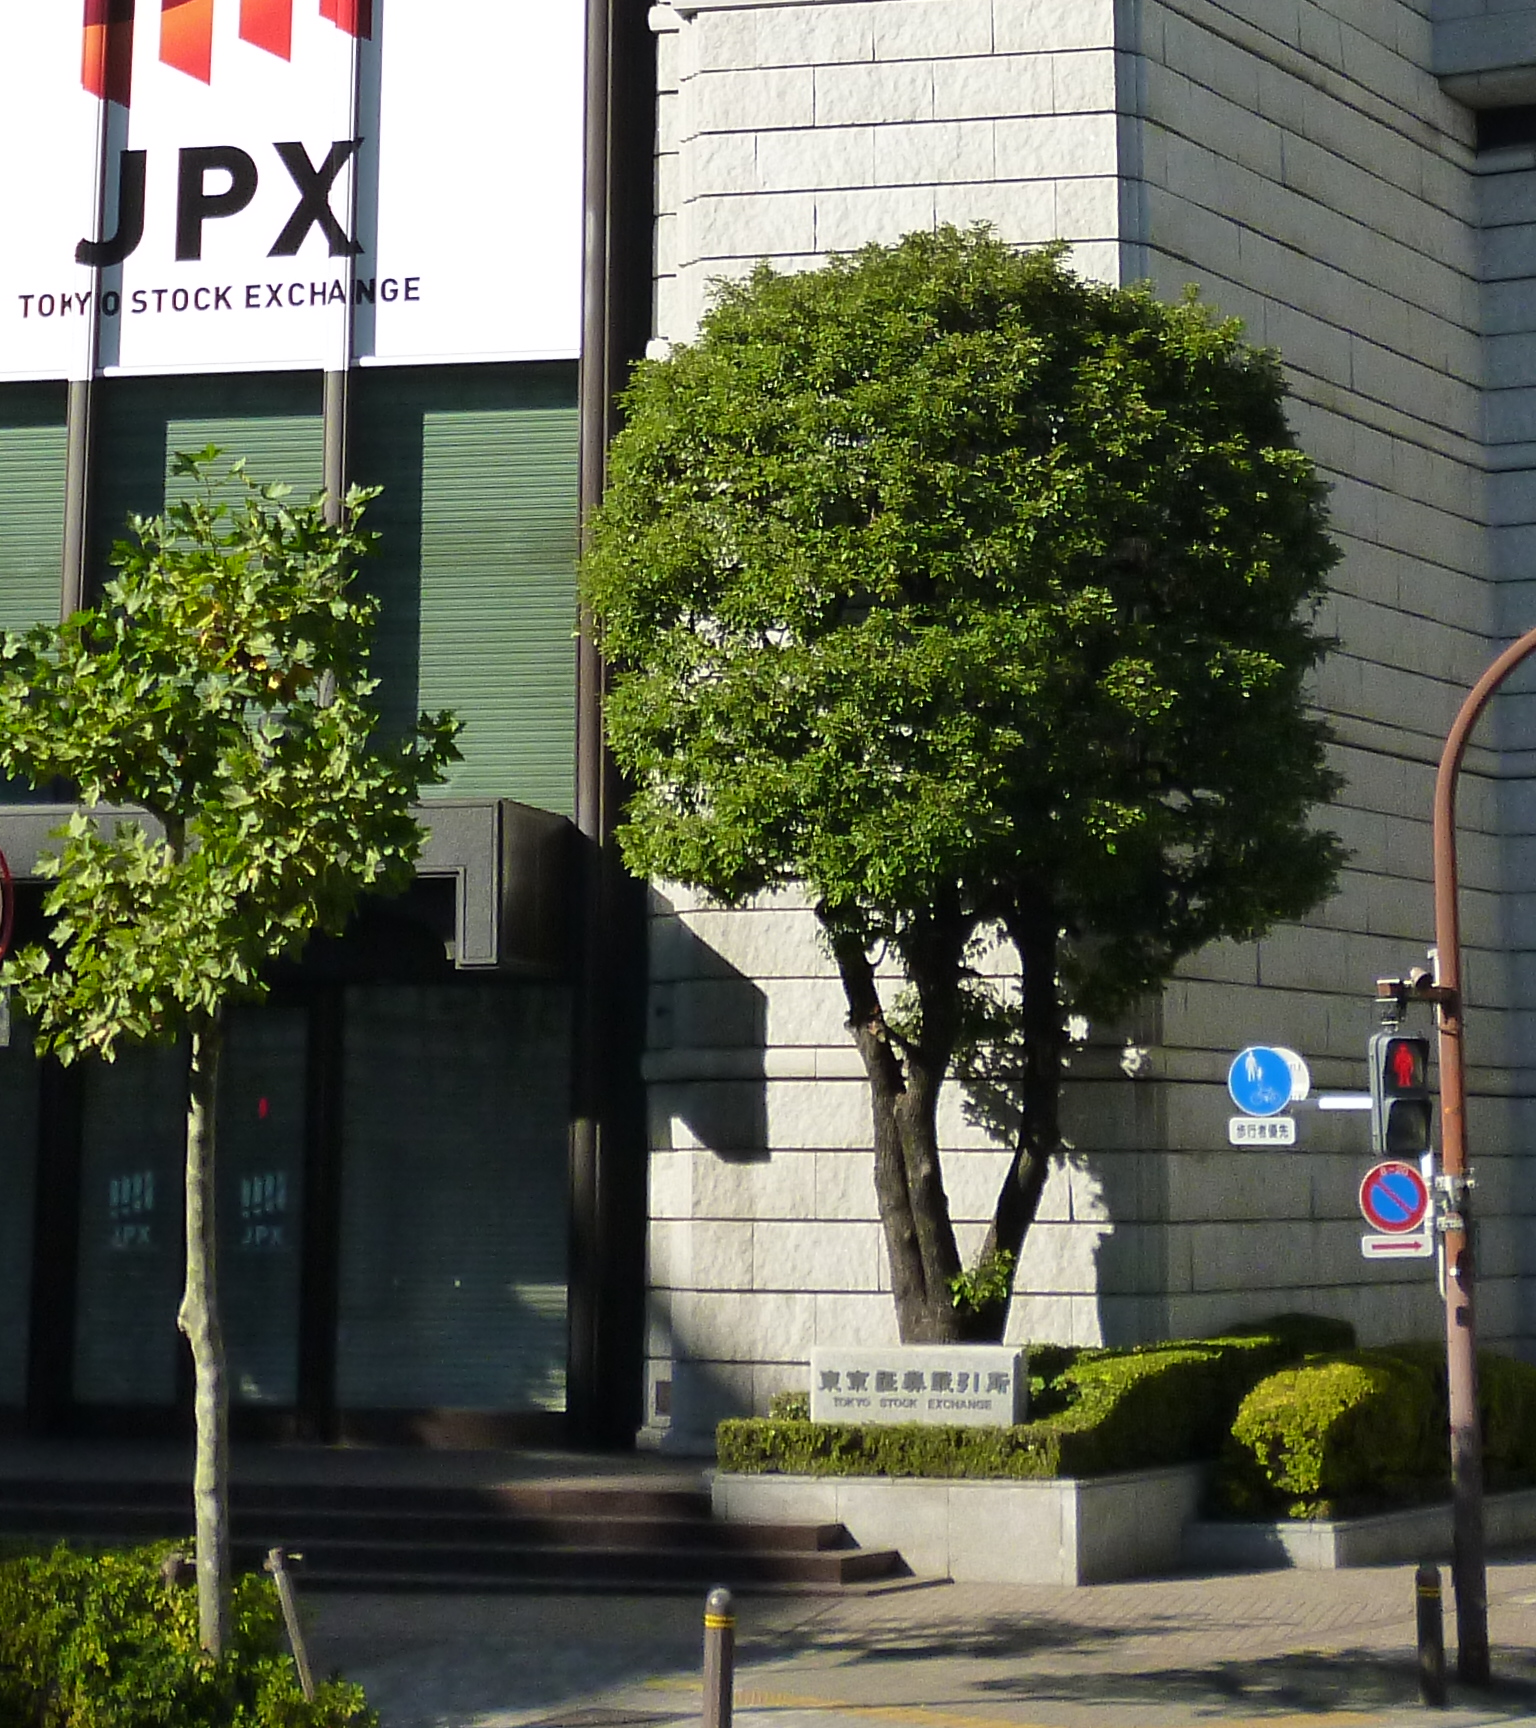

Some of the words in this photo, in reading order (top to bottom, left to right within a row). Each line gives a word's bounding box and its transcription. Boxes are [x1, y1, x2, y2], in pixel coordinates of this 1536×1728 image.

[74, 137, 365, 267] JPX
[18, 290, 120, 318] TOKYO
[131, 286, 233, 313] STOCK
[244, 277, 421, 309] EXCHANGE
[1236, 1123, 1289, 1139] 歩行者優先
[113, 1225, 150, 1248] JPX
[242, 1225, 282, 1246] JPX
[833, 1396, 871, 1408] TOKYO
[880, 1397, 918, 1409] STOCK
[927, 1398, 993, 1410] EXCHANGE
